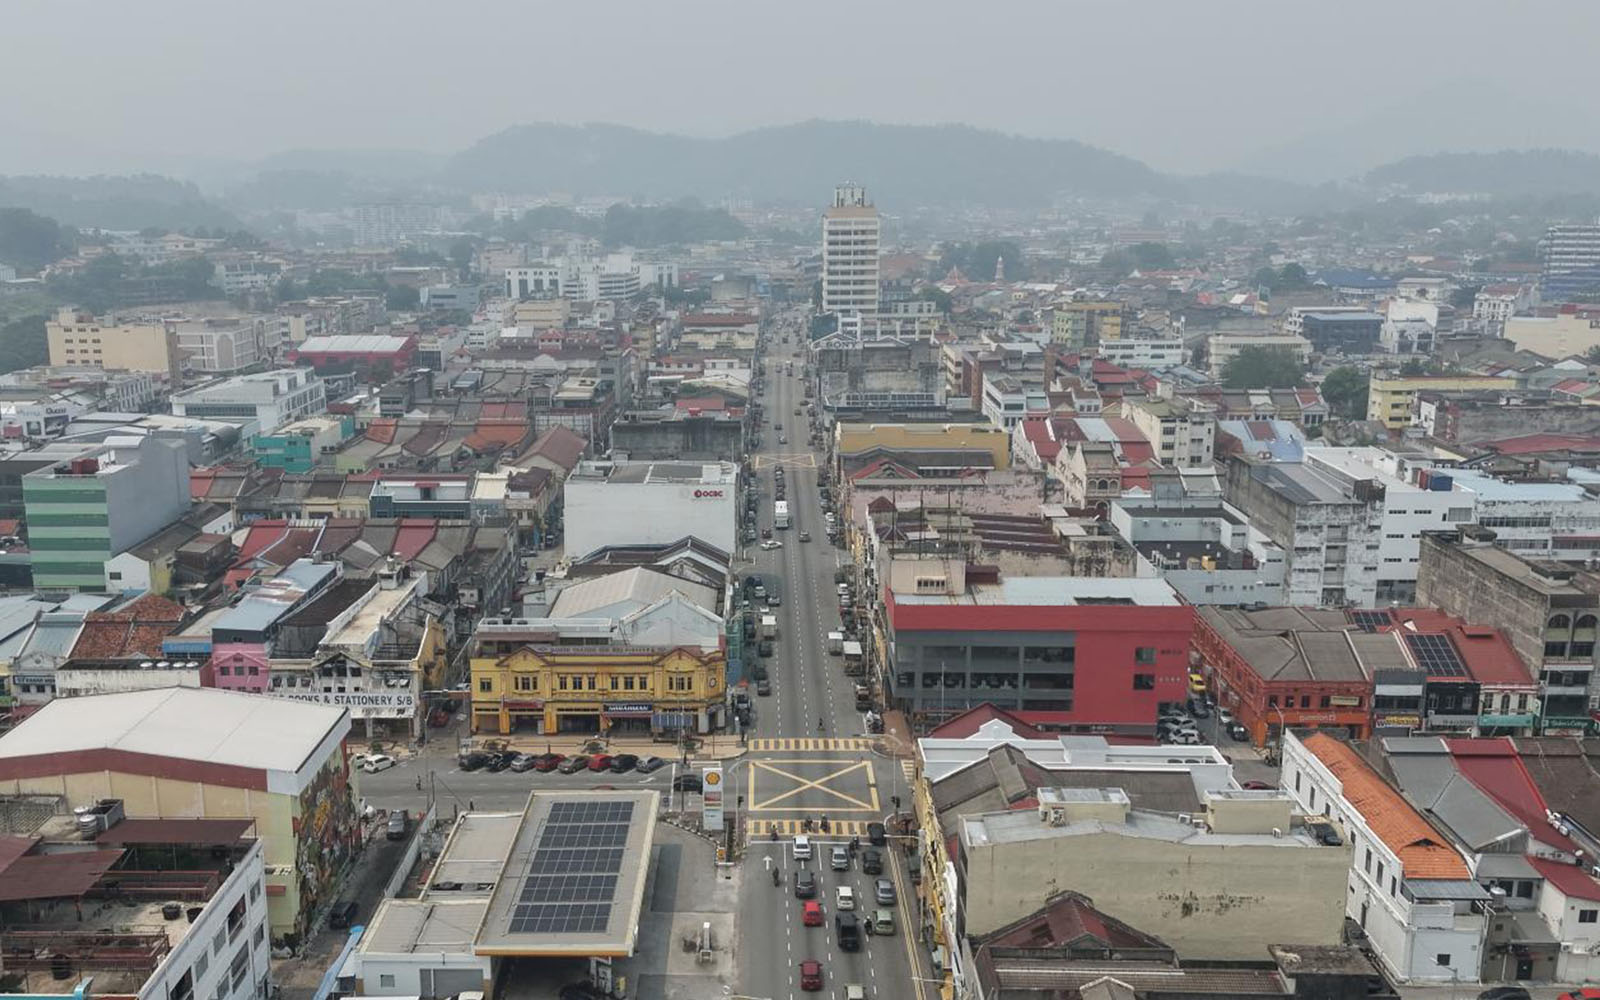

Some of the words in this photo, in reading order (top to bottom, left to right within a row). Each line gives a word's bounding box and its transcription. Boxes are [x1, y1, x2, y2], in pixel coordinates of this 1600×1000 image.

[702, 490, 724, 498] OCBC
[323, 696, 331, 704] &
[334, 695, 393, 706] STATIONERY
[396, 695, 413, 706] S/B
